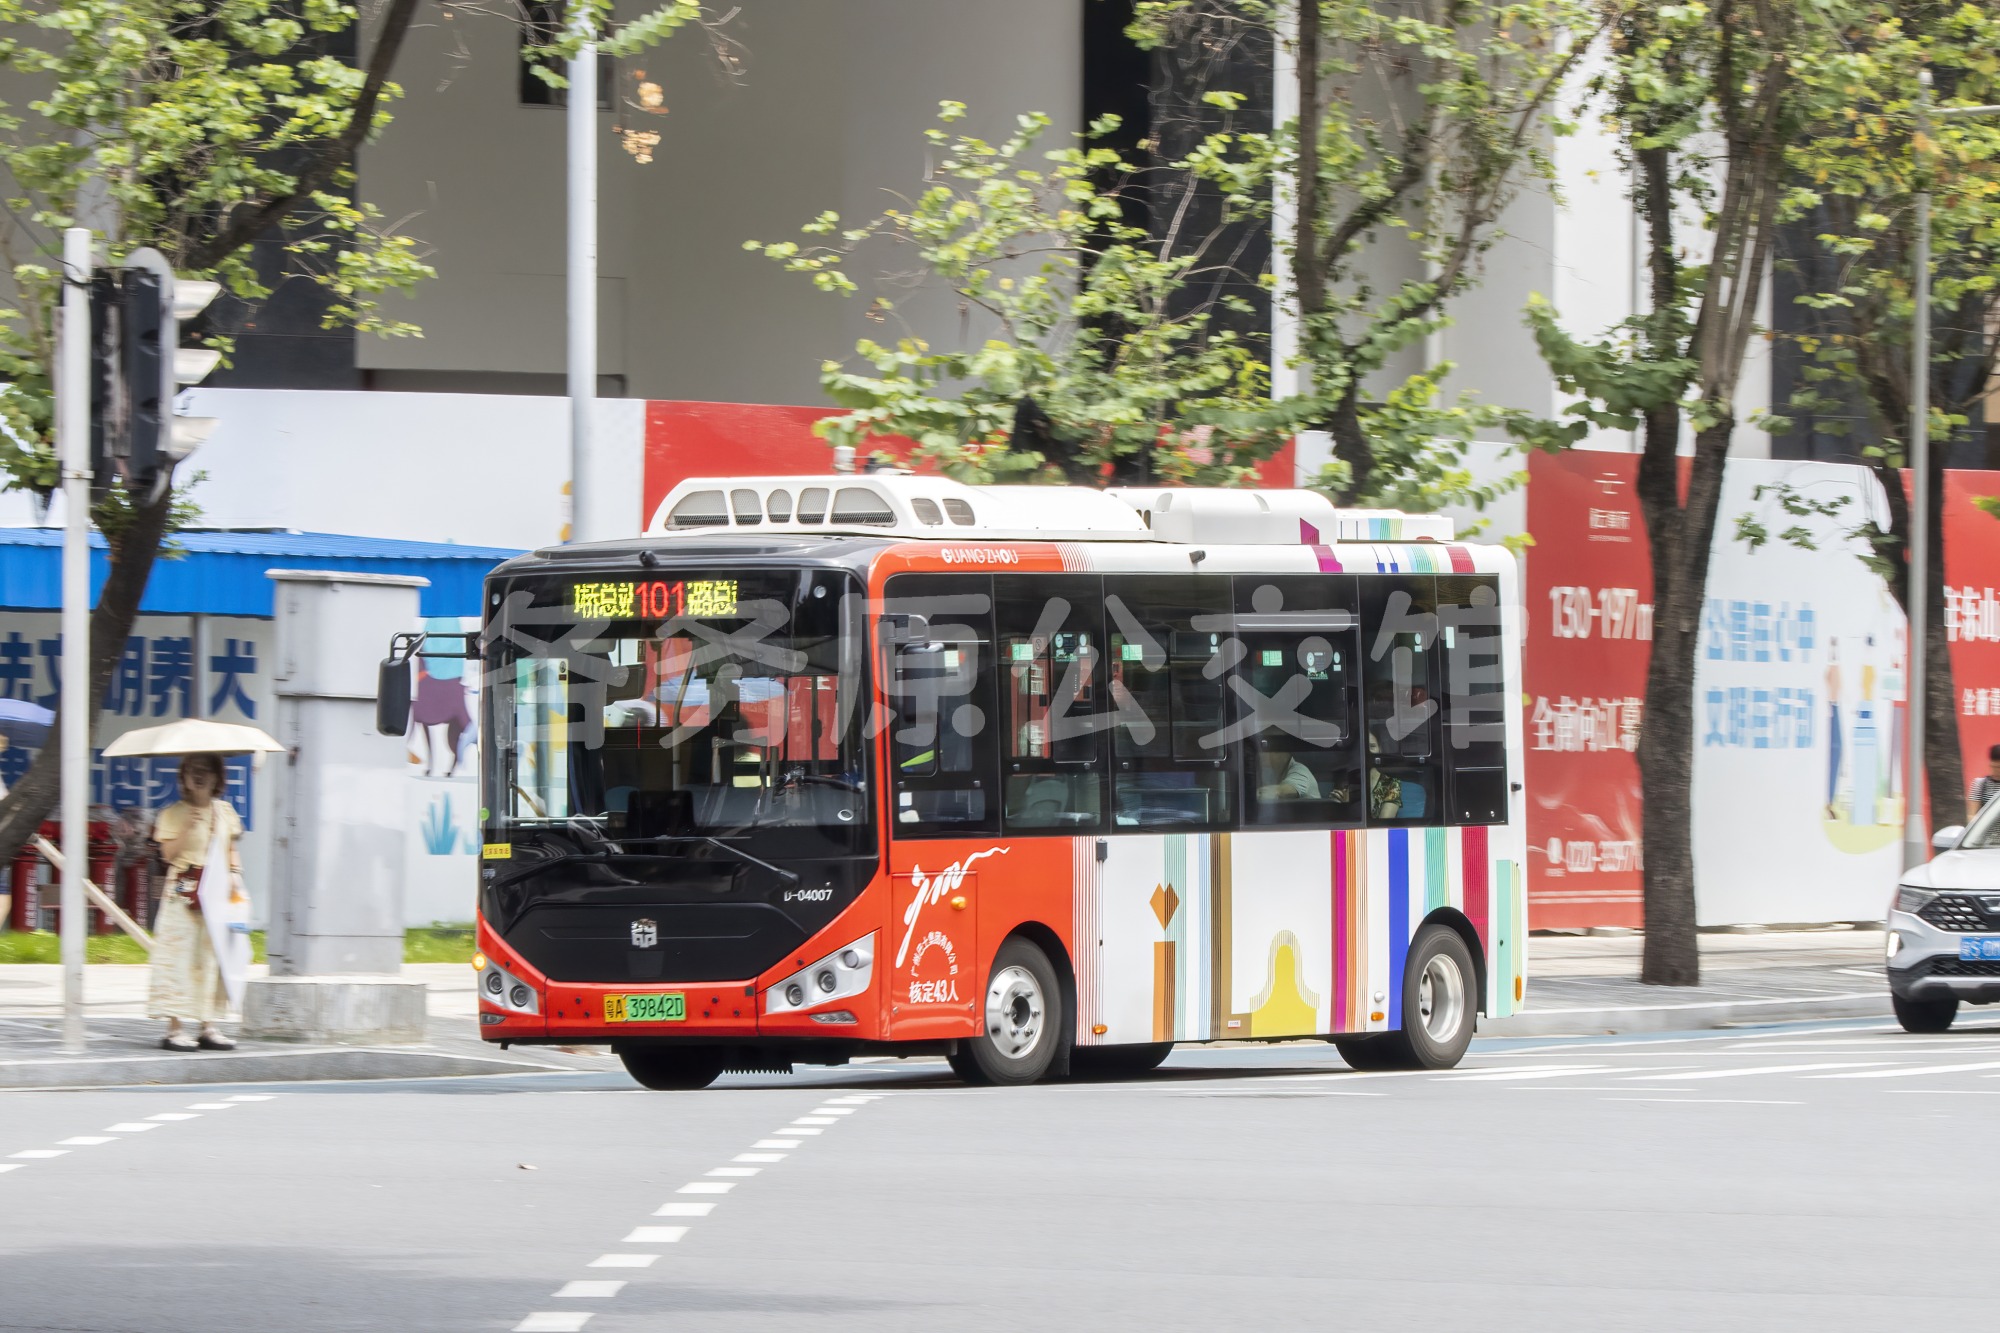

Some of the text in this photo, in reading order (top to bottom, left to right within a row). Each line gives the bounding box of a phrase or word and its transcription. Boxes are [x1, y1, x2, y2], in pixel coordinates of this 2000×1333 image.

[941, 548, 1019, 565] GUANGZHOU
[635, 580, 684, 618] 101
[908, 979, 960, 1004] 核定43人
